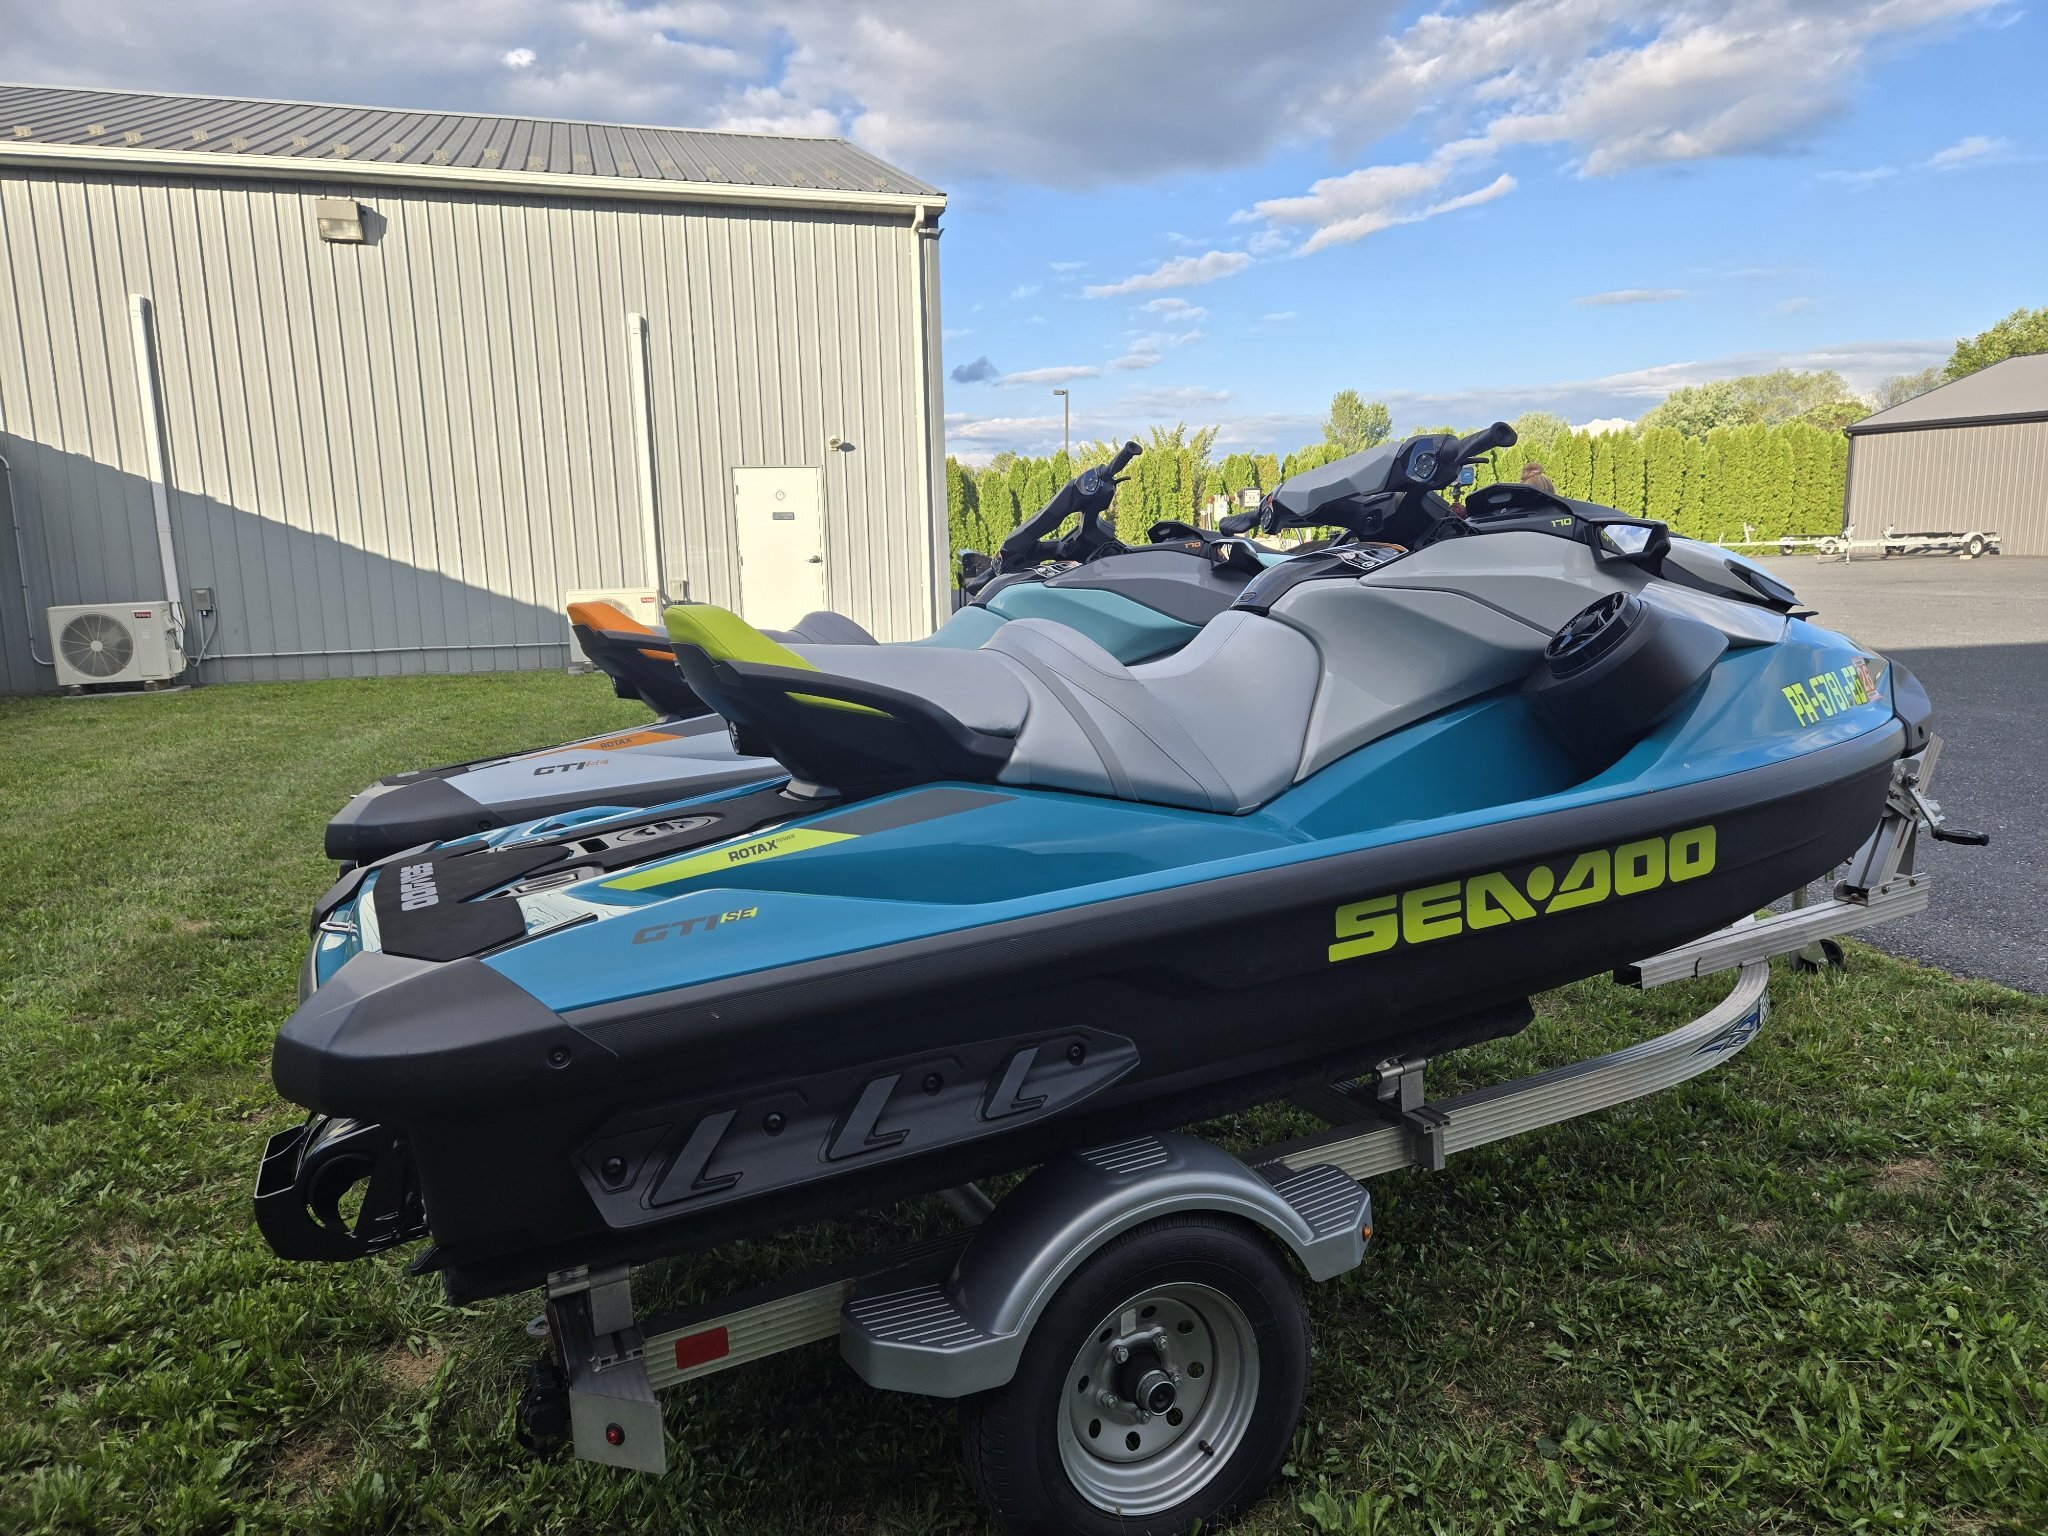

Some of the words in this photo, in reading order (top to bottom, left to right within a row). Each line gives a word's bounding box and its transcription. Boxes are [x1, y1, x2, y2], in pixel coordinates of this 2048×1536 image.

[1551, 517, 1572, 528] 170
[1184, 541, 1201, 549] 170
[600, 737, 632, 750] ROTAX
[533, 761, 586, 776] GTI
[728, 840, 778, 862] ROTAX
[776, 833, 796, 844] POWER
[631, 914, 720, 945] GTI
[722, 907, 757, 923] SE
